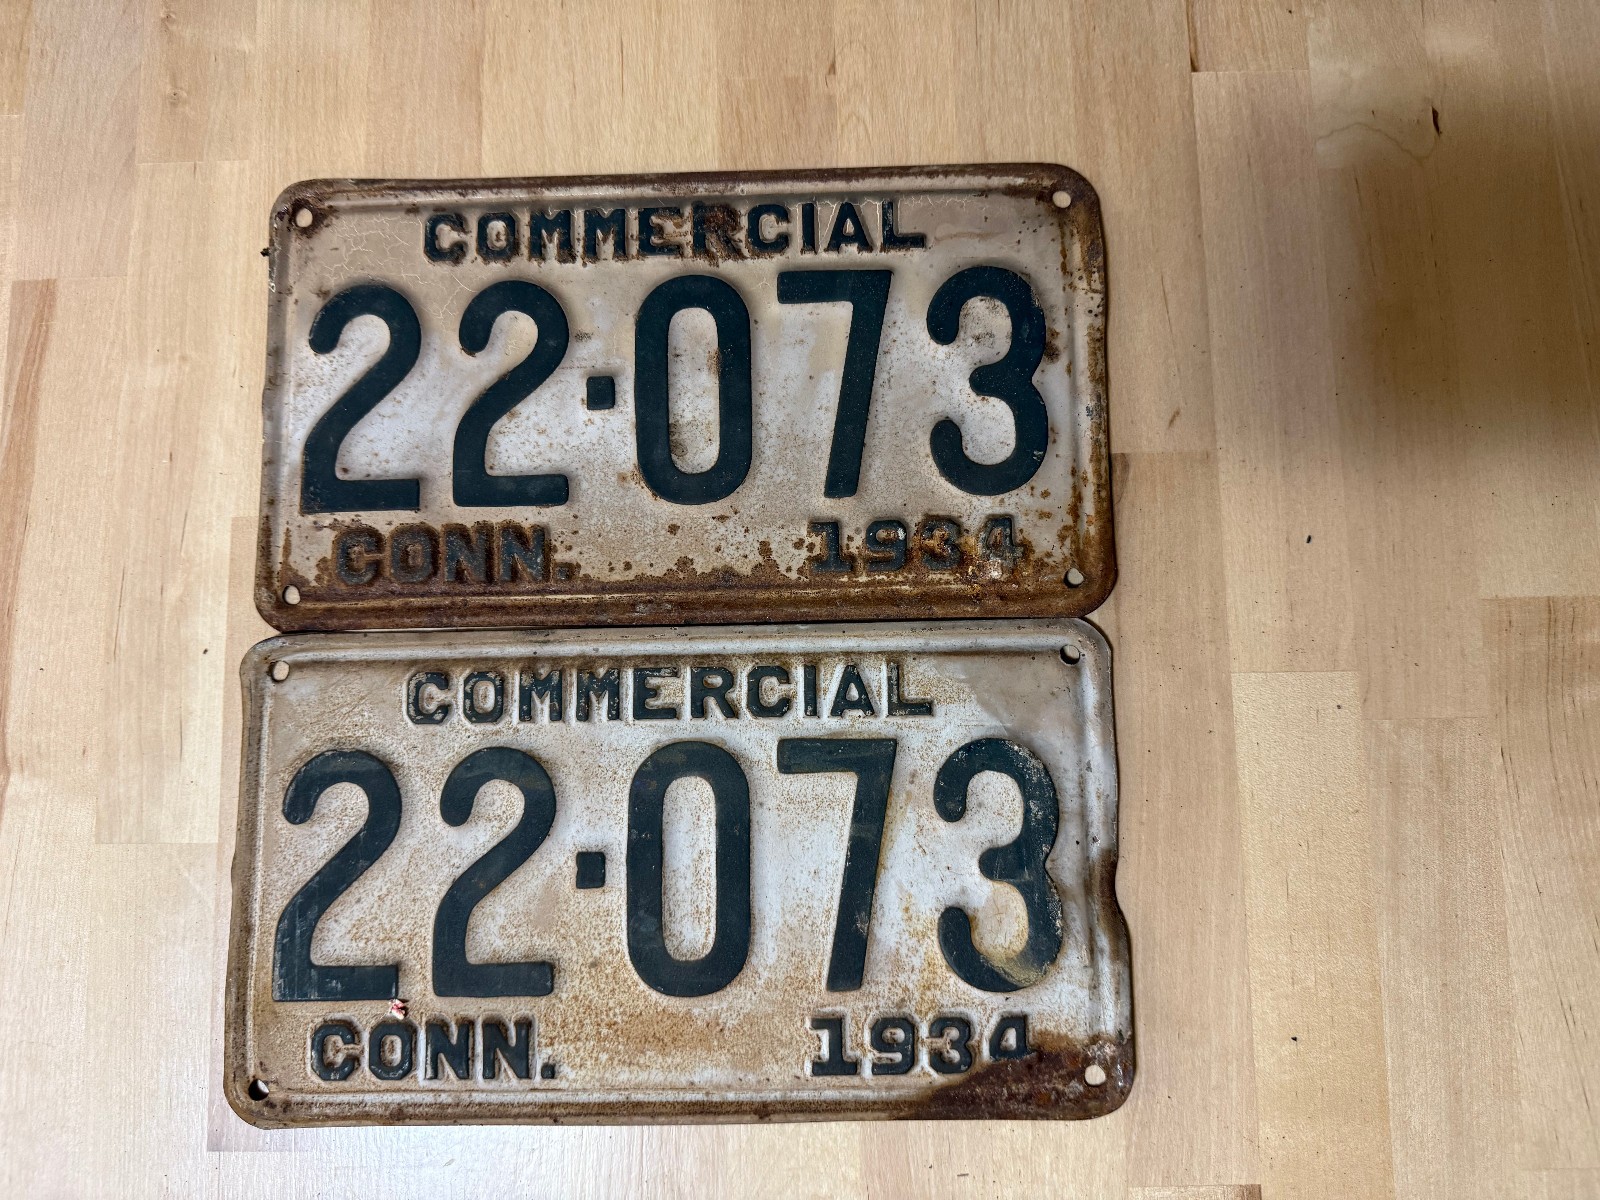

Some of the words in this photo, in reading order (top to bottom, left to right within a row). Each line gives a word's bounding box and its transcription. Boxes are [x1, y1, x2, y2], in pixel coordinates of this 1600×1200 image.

[424, 200, 926, 264] COMMERCIAL
[336, 523, 571, 585] CONN.
[808, 515, 1024, 574] 1934
[408, 664, 933, 723] COMMERCIAL
[311, 1020, 556, 1081] CONN.
[811, 1014, 1030, 1075] 1934
